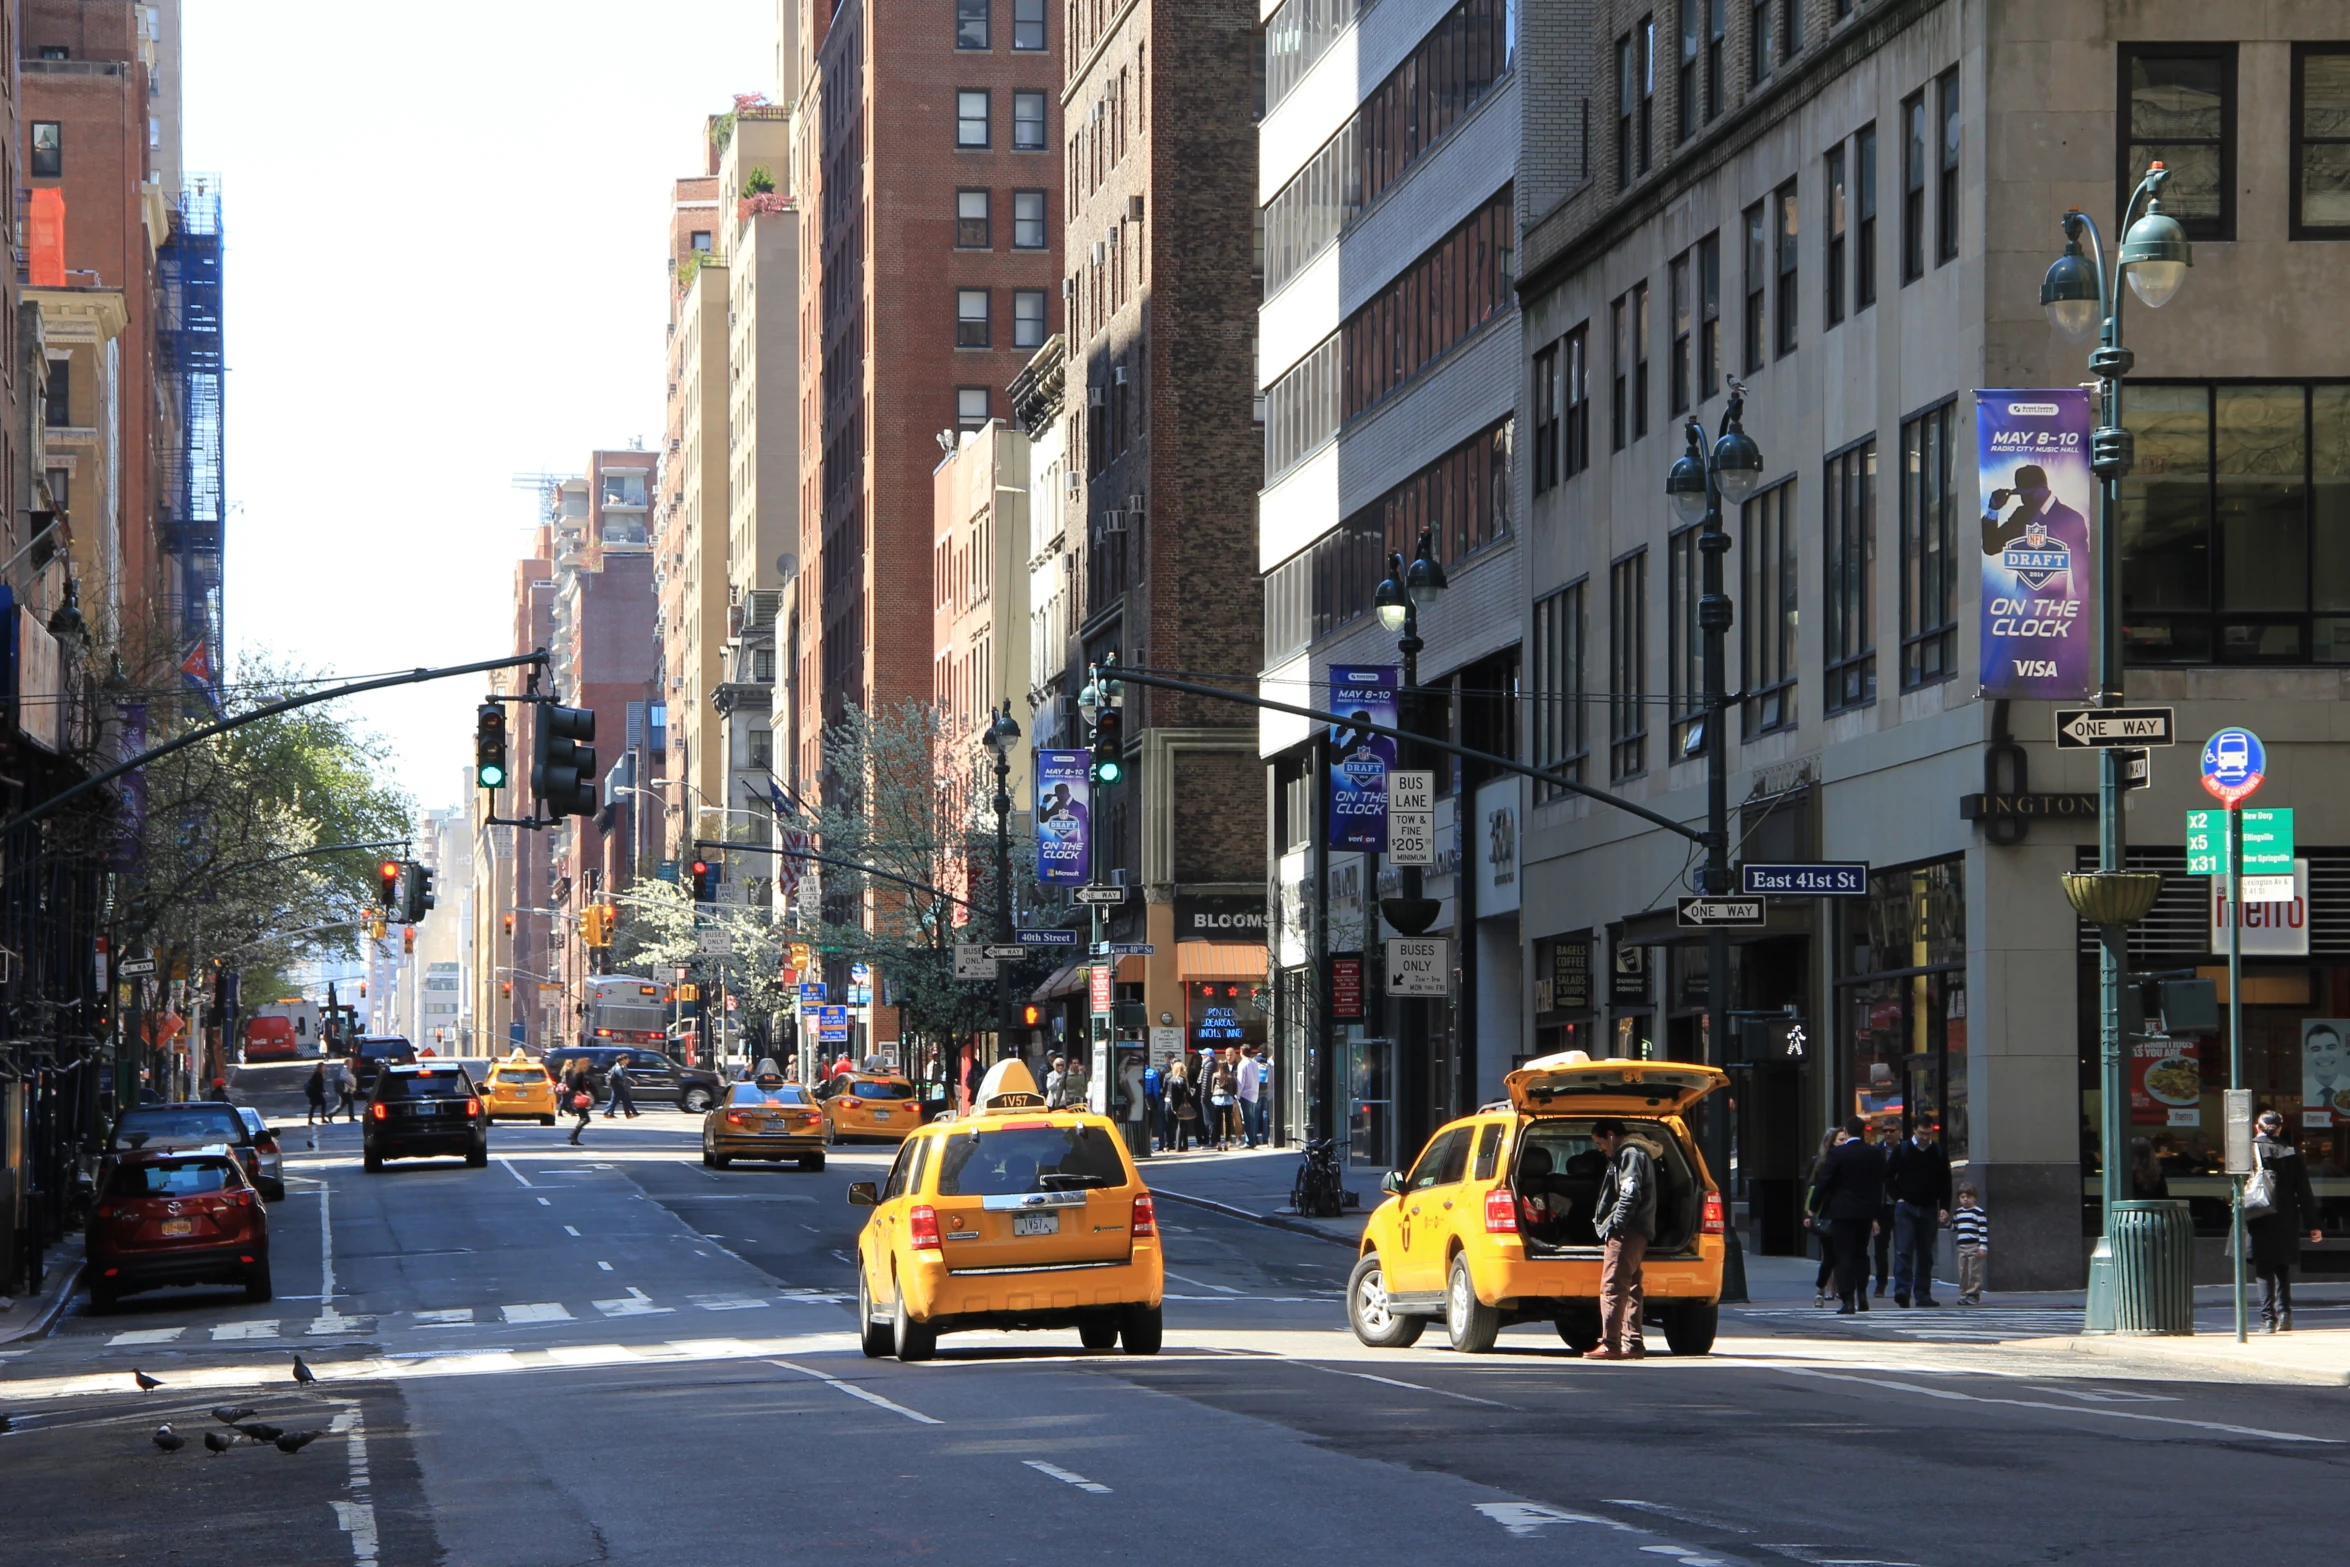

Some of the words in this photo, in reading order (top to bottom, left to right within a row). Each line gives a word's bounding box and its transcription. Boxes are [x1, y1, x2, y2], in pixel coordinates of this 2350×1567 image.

[1992, 431, 2035, 444] MAY
[2036, 432, 2079, 445] 8-10
[2030, 534, 2044, 545] NFL
[2008, 554, 2064, 567] DRAFT
[1990, 598, 2027, 616] ON
[2034, 599, 2081, 618] THE
[1992, 618, 2072, 638] CLOCK
[2012, 660, 2058, 678] VISA
[1338, 690, 1364, 698] MAY
[1364, 690, 1390, 699] 8-10
[2075, 722, 2107, 736] ONE
[2123, 720, 2157, 735] WAY
[1346, 764, 1381, 772] DRAFT
[1400, 776, 1423, 790] BUS
[2208, 778, 2220, 790] NO
[2220, 776, 2259, 797] STANDING
[1335, 791, 1358, 802] ON
[1361, 792, 1388, 803] THE
[1396, 794, 1427, 808] LANE
[1336, 804, 1385, 815] CLOCK
[1396, 816, 1416, 824] TOW
[1420, 816, 1426, 824] &
[2189, 812, 2208, 829] x2
[2242, 812, 2257, 820] New
[2258, 812, 2273, 820] Dorp
[1402, 826, 1422, 836] FINE
[2190, 834, 2208, 850] x5
[2242, 832, 2274, 842] Eltingville
[1042, 842, 1059, 850] ON
[1062, 842, 1084, 851] THE
[1043, 850, 1080, 860] CLOCK
[2258, 854, 2290, 863] Springville
[2190, 856, 2216, 872] x31
[1753, 872, 1792, 888] East
[1796, 872, 1832, 888] 41st
[1837, 872, 1856, 888] St
[1691, 906, 1715, 917] ONE
[1726, 906, 1753, 916] WAY
[1022, 933, 1041, 942] 40th
[1043, 933, 1070, 942] Street
[1110, 946, 1127, 954] East
[1144, 946, 1152, 954] St
[1400, 944, 1434, 956] BUSES
[1556, 945, 1586, 955] BAGELS
[1404, 960, 1432, 972] ONLY
[1556, 957, 1586, 967] COFFEE
[1556, 975, 1586, 986] SALADS
[1556, 986, 1562, 994] &
[1563, 986, 1586, 995] SOUPS
[2145, 1048, 2163, 1058] YOU
[2164, 1048, 2181, 1057] ARE
[1002, 1096, 1028, 1107] 1V57
